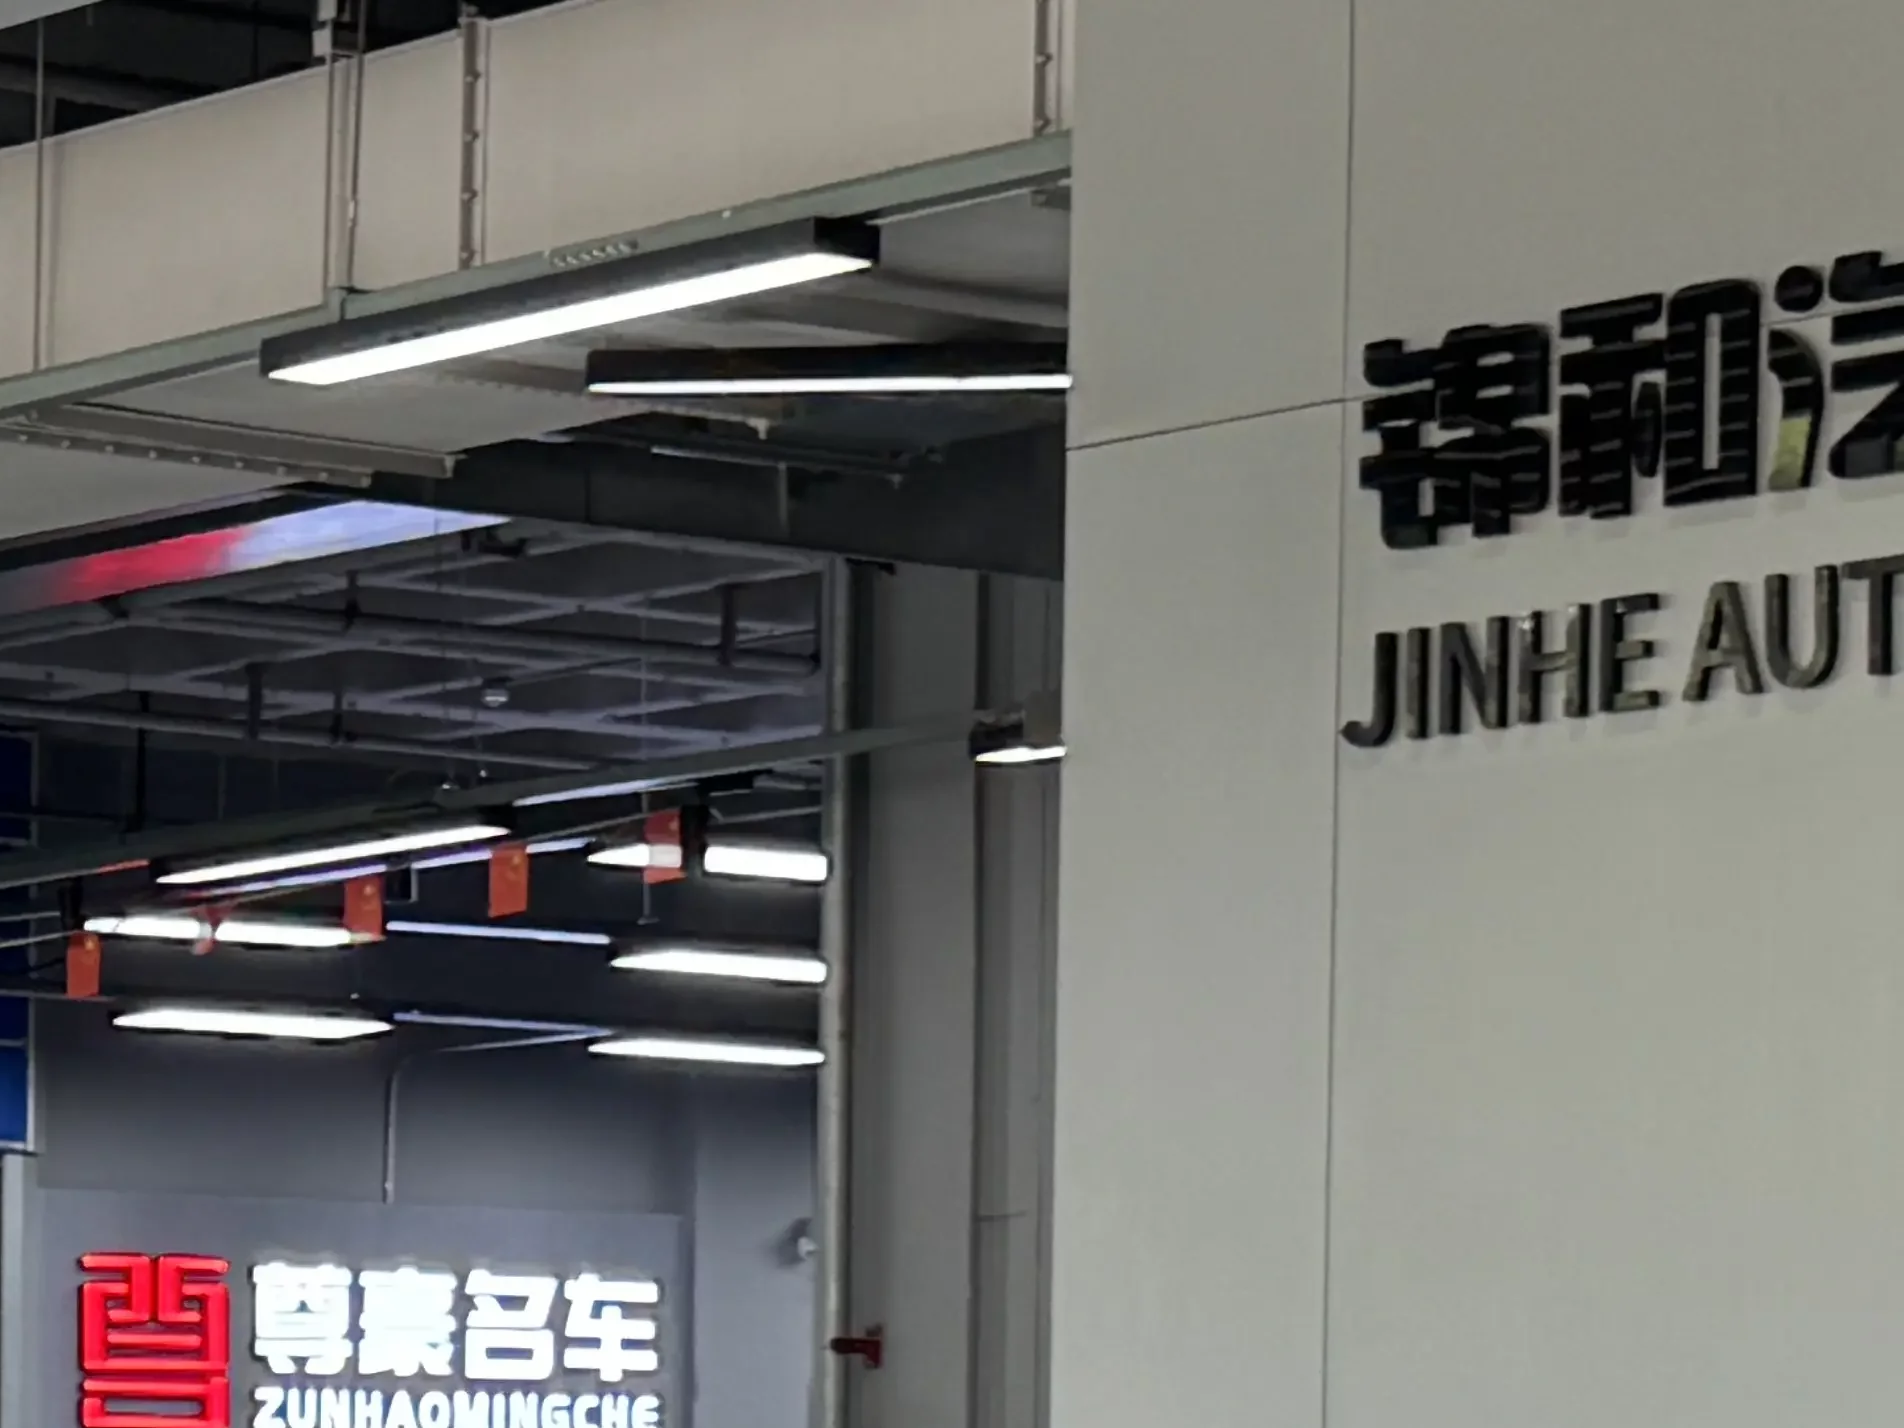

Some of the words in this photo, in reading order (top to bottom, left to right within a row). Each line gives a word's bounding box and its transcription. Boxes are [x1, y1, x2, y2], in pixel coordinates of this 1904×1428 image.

[1340, 592, 1661, 748] JINHE
[251, 1261, 660, 1382] 尊豪名车
